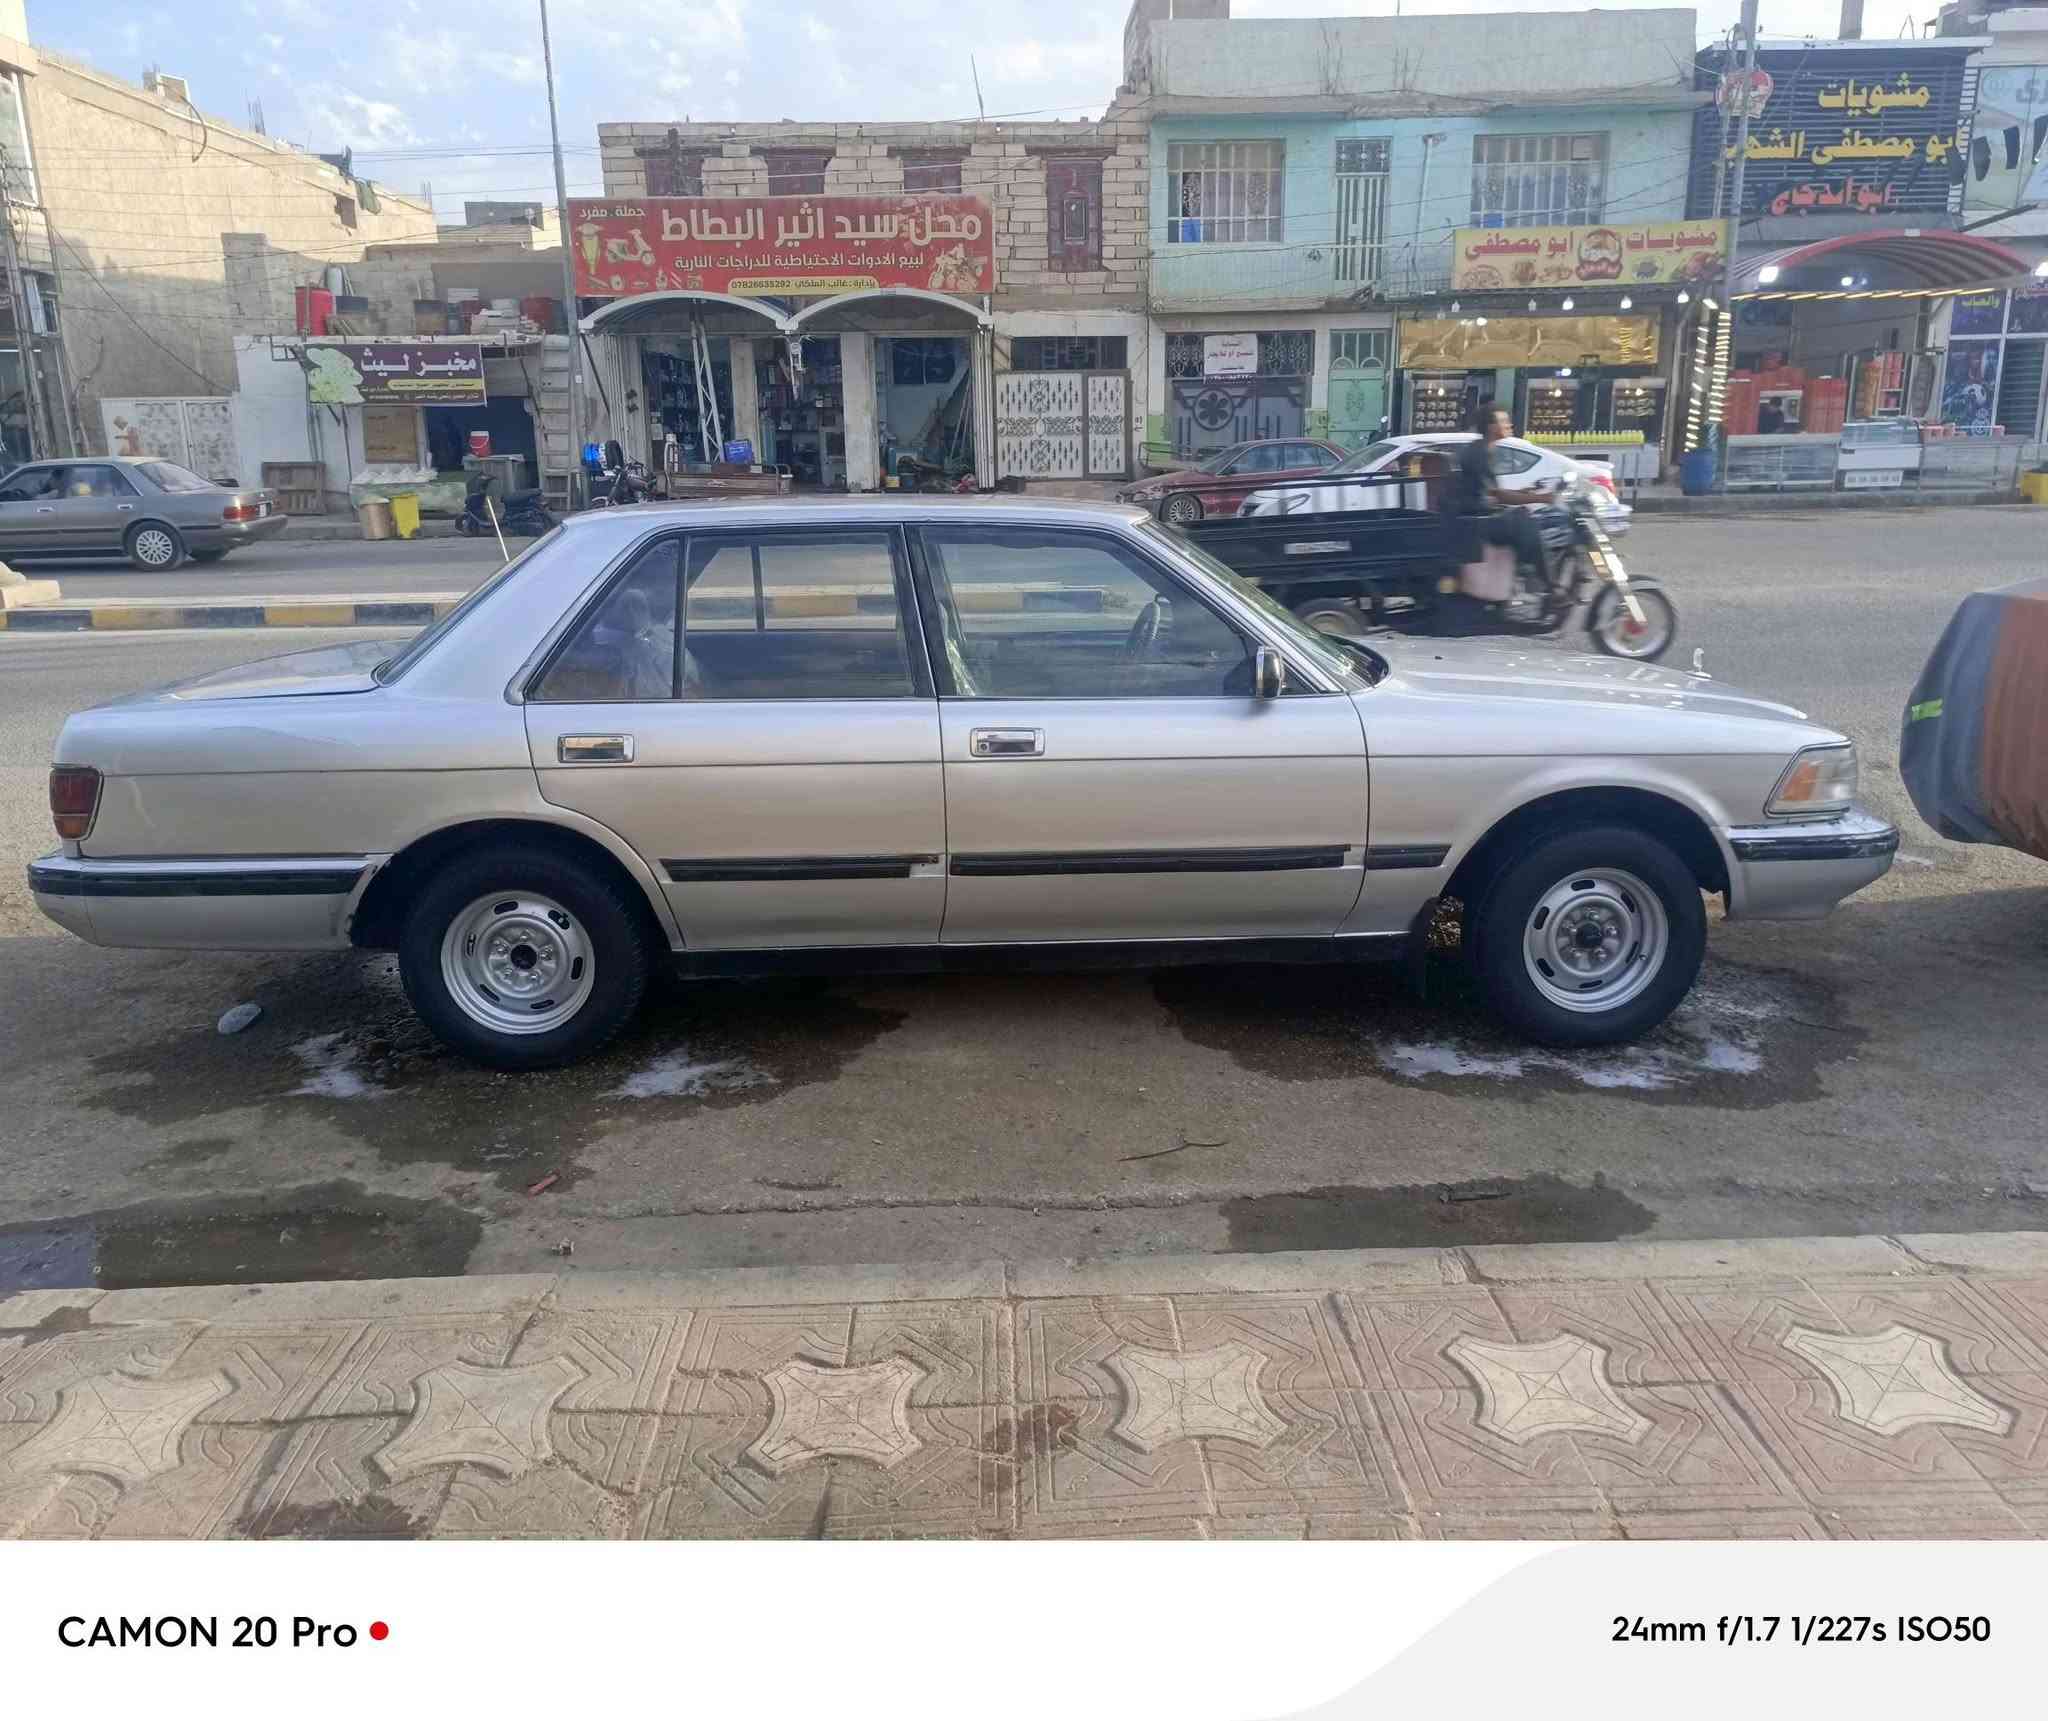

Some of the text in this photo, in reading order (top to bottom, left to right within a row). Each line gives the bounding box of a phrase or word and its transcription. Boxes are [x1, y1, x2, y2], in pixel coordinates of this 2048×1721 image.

[1818, 72, 1931, 116] مشويات
[1811, 127, 1917, 165] مصطفى
[579, 204, 646, 220] حملة مفرد
[660, 201, 983, 248] محل سيد اثير البطاط
[1465, 225, 1718, 260] مشويات ابو مصطفى
[675, 255, 713, 271] النارية
[716, 254, 771, 269] للدراجات
[775, 253, 844, 270] الاحتياطية
[898, 252, 924, 269] لبيع
[360, 347, 478, 377] مخبز ليث
